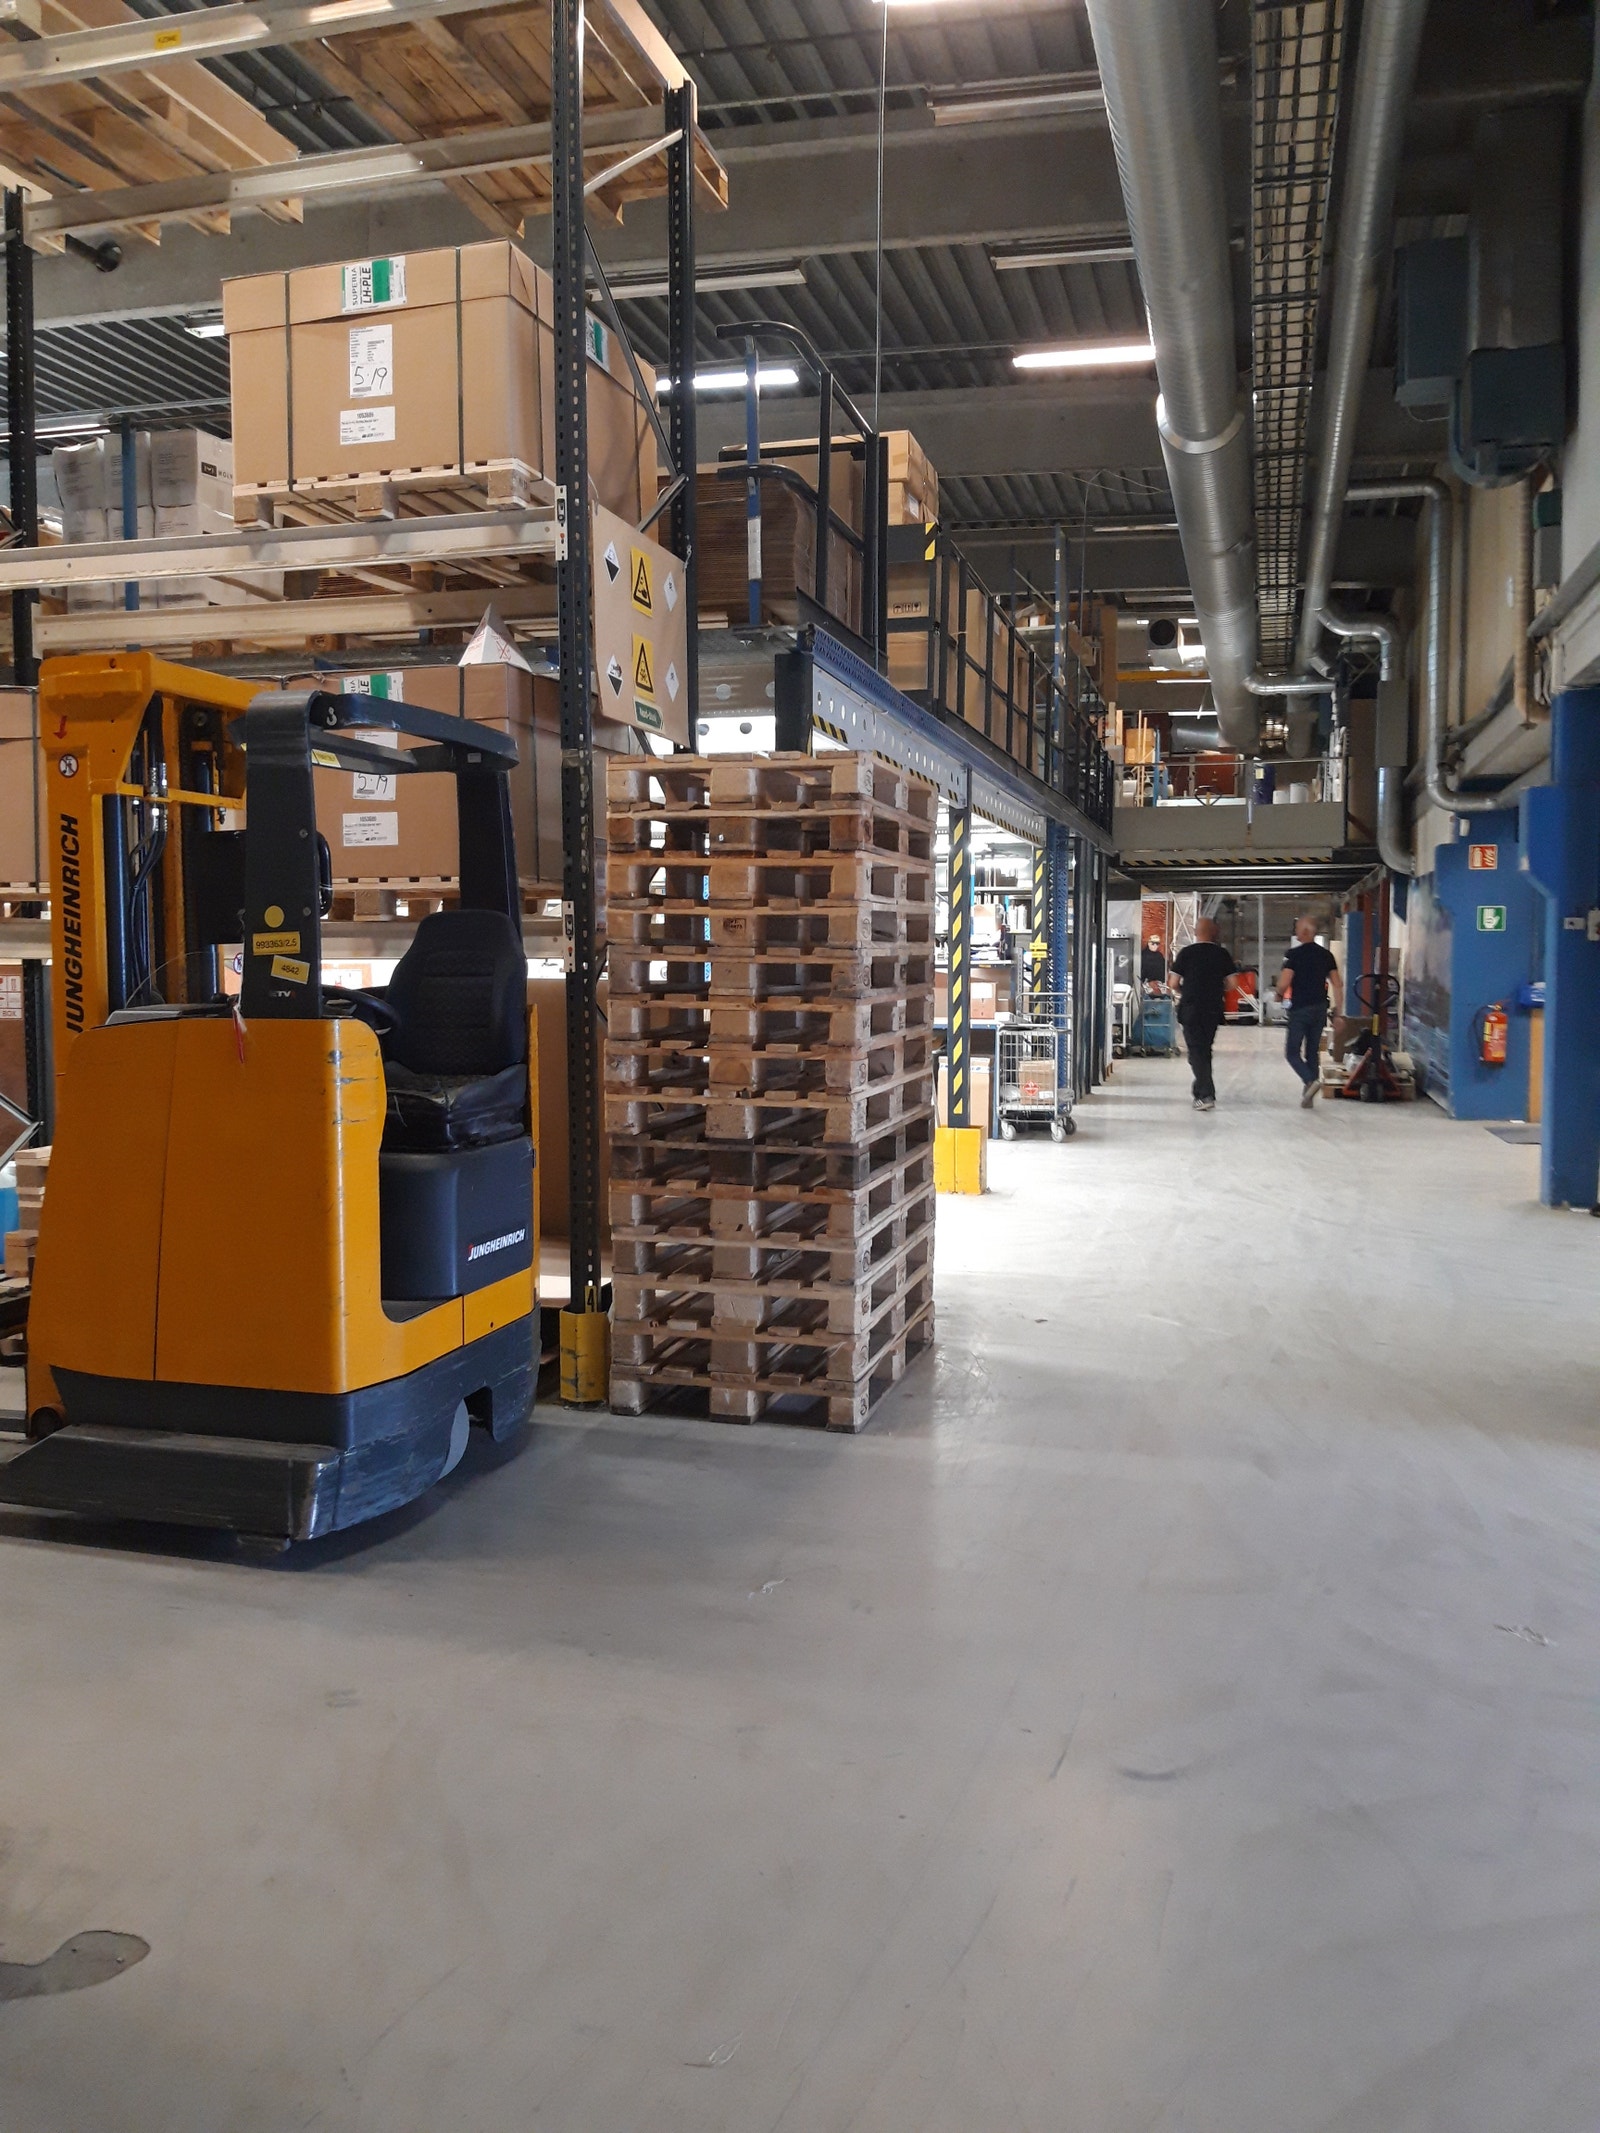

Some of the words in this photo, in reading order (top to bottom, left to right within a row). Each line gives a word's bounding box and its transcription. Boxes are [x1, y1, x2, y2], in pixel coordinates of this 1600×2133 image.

[351, 267, 359, 306] SUPERIA
[361, 266, 372, 304] LH-PLE
[60, 813, 85, 1034] JUNGHEINRICH
[281, 964, 300, 976] 4842
[468, 1228, 526, 1262] JUNGHEINRICH
[587, 1288, 594, 1312] 4
